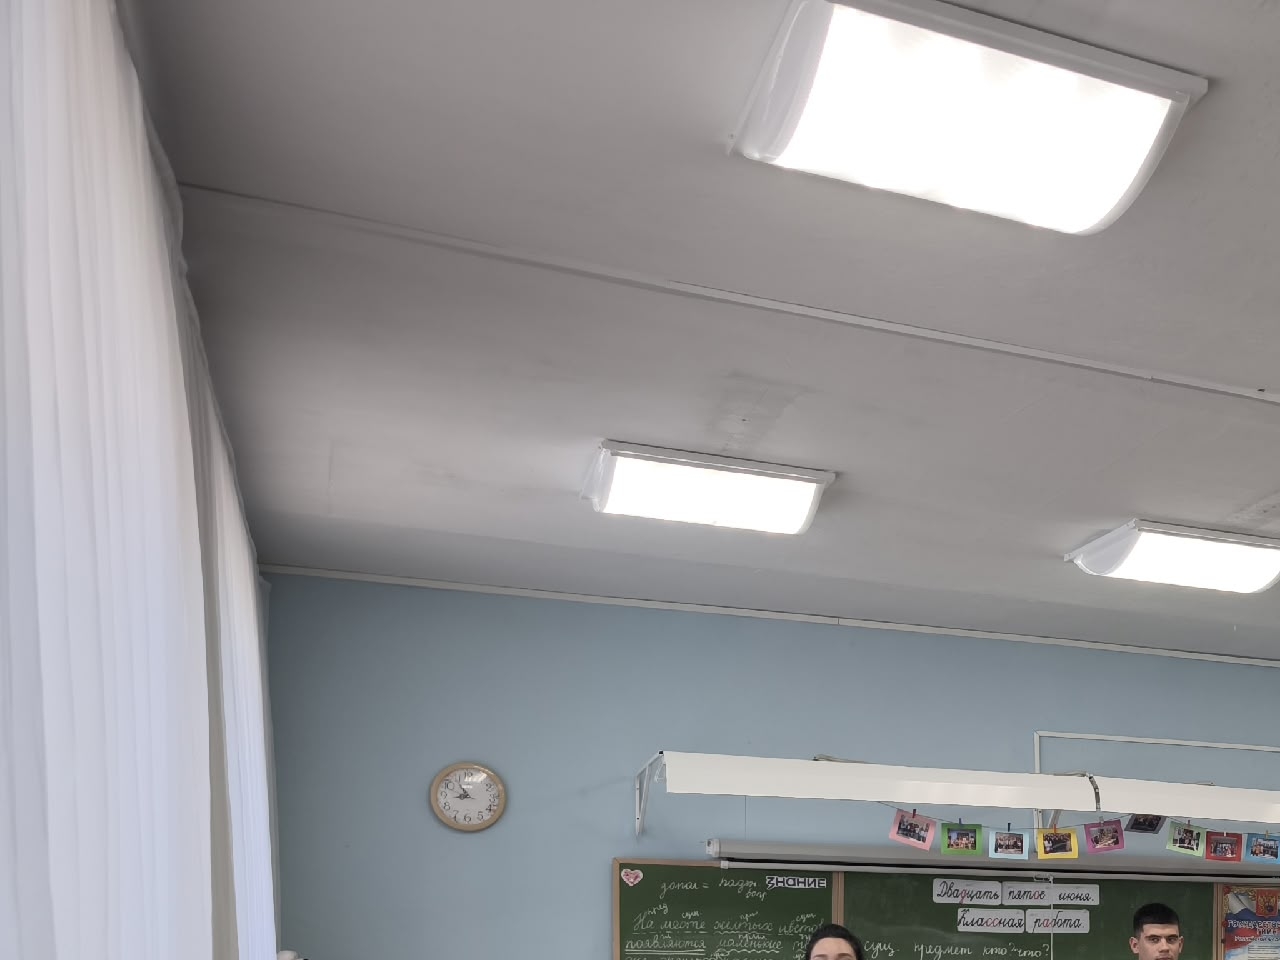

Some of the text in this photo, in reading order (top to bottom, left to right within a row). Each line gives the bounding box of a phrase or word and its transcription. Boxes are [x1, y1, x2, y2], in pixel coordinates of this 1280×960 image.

[766, 876, 826, 890] ЗНАНИЕ
[936, 880, 1000, 904] Двадцать
[1008, 888, 1046, 900] пятое
[957, 909, 1025, 929] Классная
[914, 943, 973, 960] предмет
